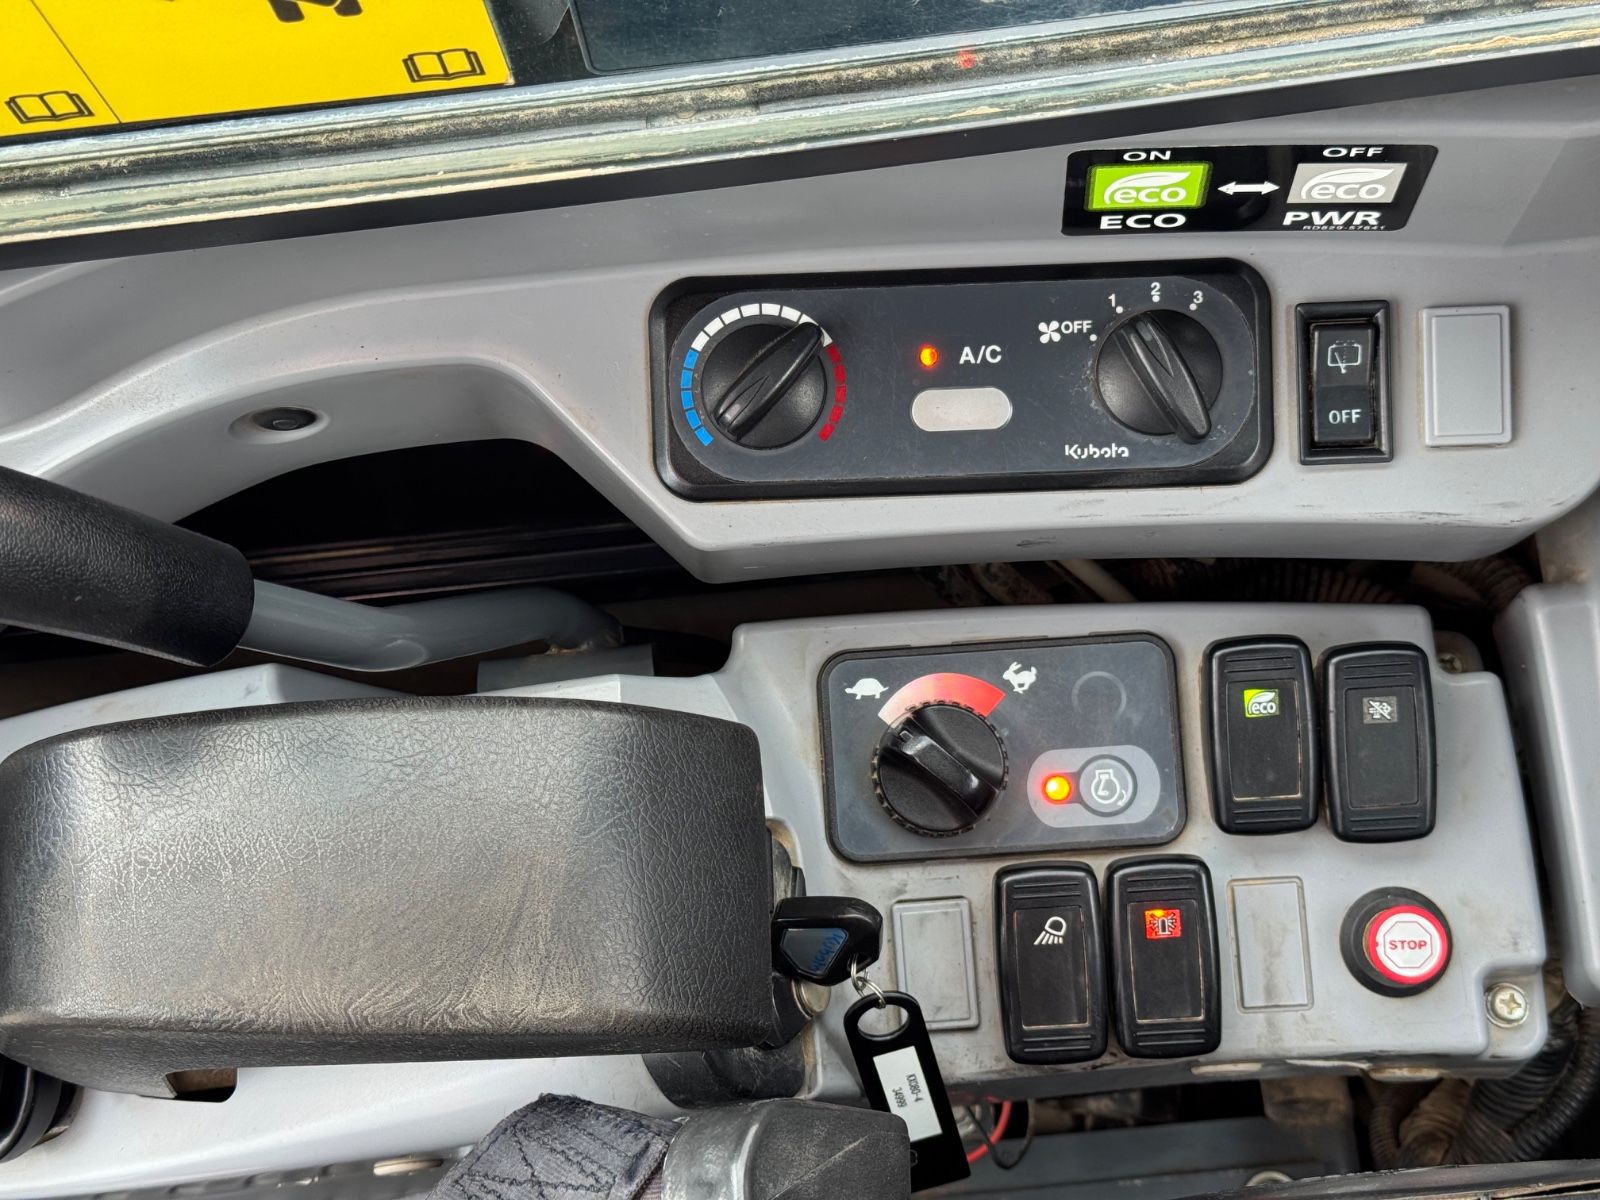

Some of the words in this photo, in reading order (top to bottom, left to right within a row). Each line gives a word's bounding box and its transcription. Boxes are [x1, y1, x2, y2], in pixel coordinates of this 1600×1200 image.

[1123, 150, 1171, 161] ON
[1322, 147, 1384, 157] OFF
[1114, 187, 1187, 203] eco
[1311, 184, 1386, 199] eco
[1100, 213, 1187, 229] ECO
[1282, 211, 1382, 225] PWR
[1150, 282, 1161, 295] 2
[1108, 294, 1116, 307] 1
[1193, 290, 1203, 304] 3
[1061, 320, 1092, 334] OFF
[959, 344, 1002, 364] A/C
[1329, 409, 1362, 424] OFF
[1064, 443, 1129, 459] Kubota
[1251, 701, 1277, 714] eco
[1388, 939, 1428, 950] STOP
